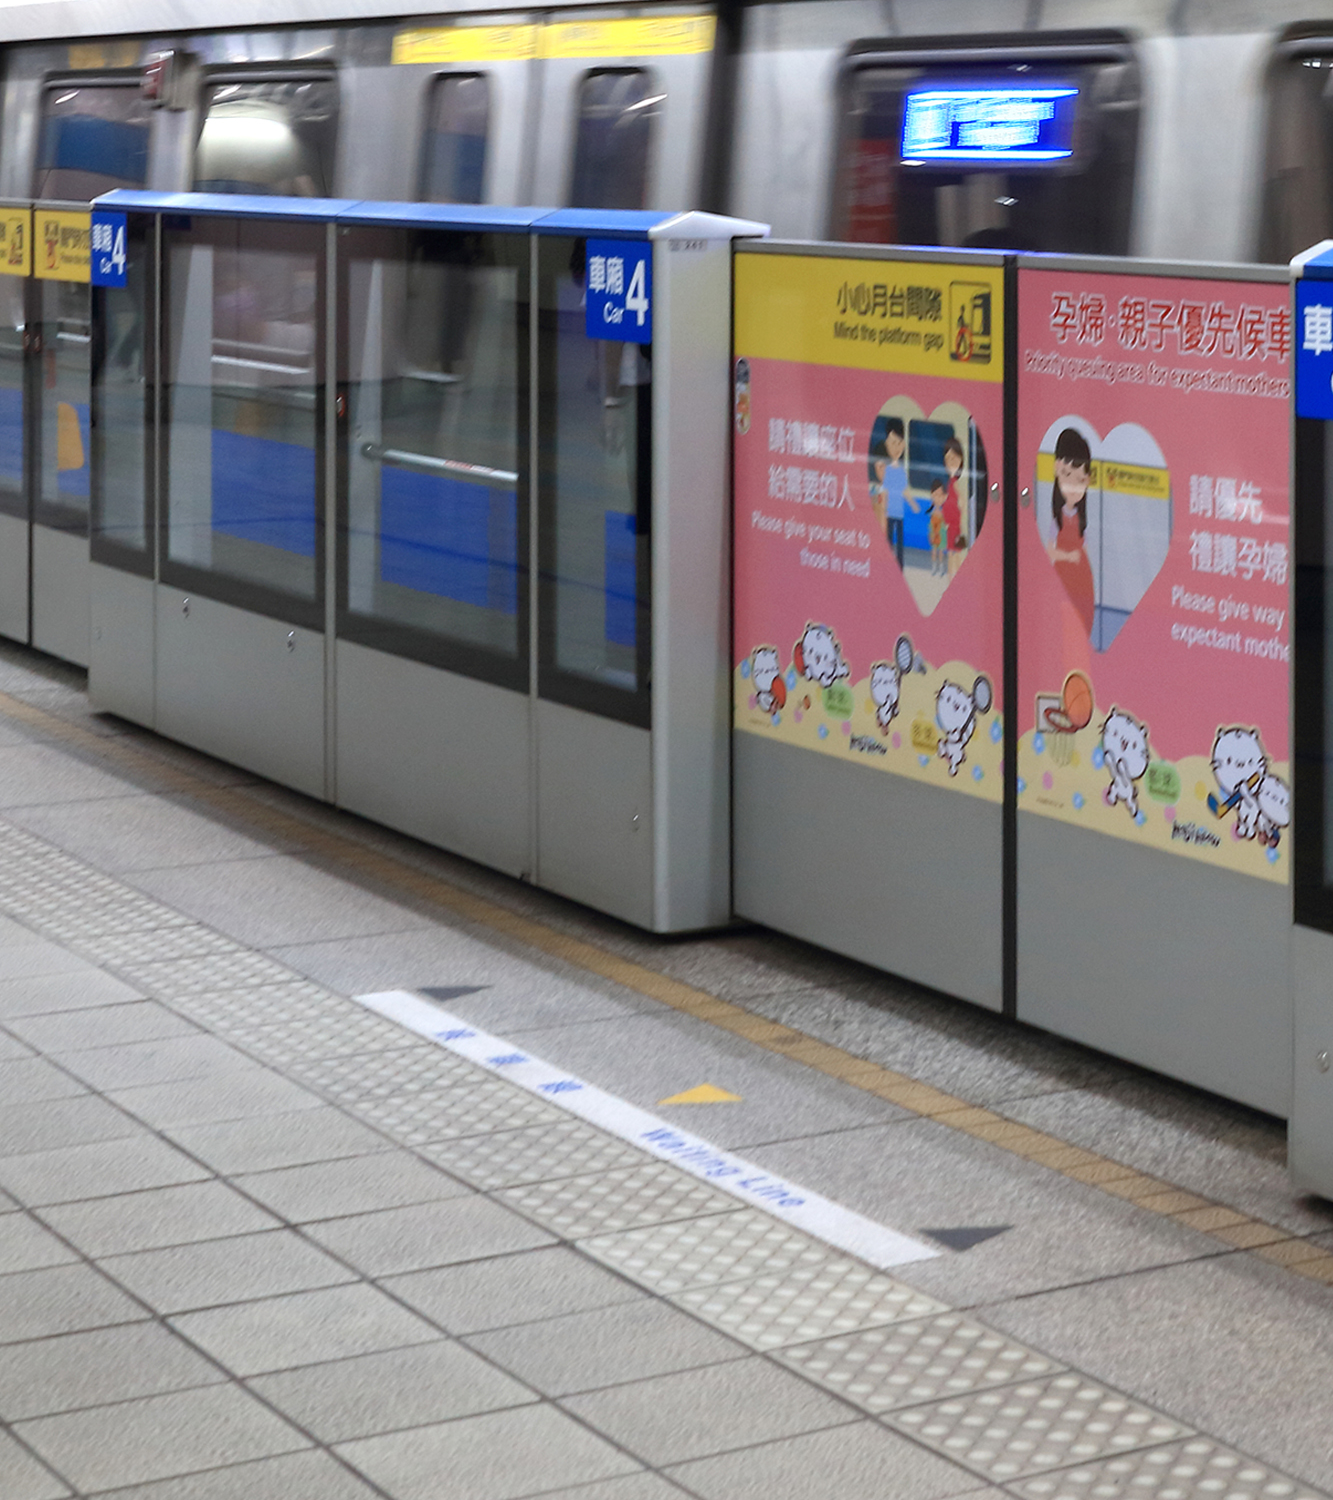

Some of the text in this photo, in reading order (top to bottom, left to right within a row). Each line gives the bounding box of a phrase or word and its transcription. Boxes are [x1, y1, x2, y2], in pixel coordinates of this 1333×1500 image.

[112, 225, 126, 275] 4
[589, 255, 649, 327] 車廂 4
[603, 301, 625, 324] Car
[834, 321, 944, 352] Mind the platform gap
[1117, 362, 1145, 384] area
[1147, 361, 1168, 387] for
[1170, 367, 1233, 394] expectant
[1189, 474, 1263, 524] 請優先
[752, 510, 870, 549] Please give your seat to
[1189, 529, 1289, 586] 禮讓孕婦
[1171, 585, 1286, 632] Please give way
[1171, 622, 1241, 652] expectant
